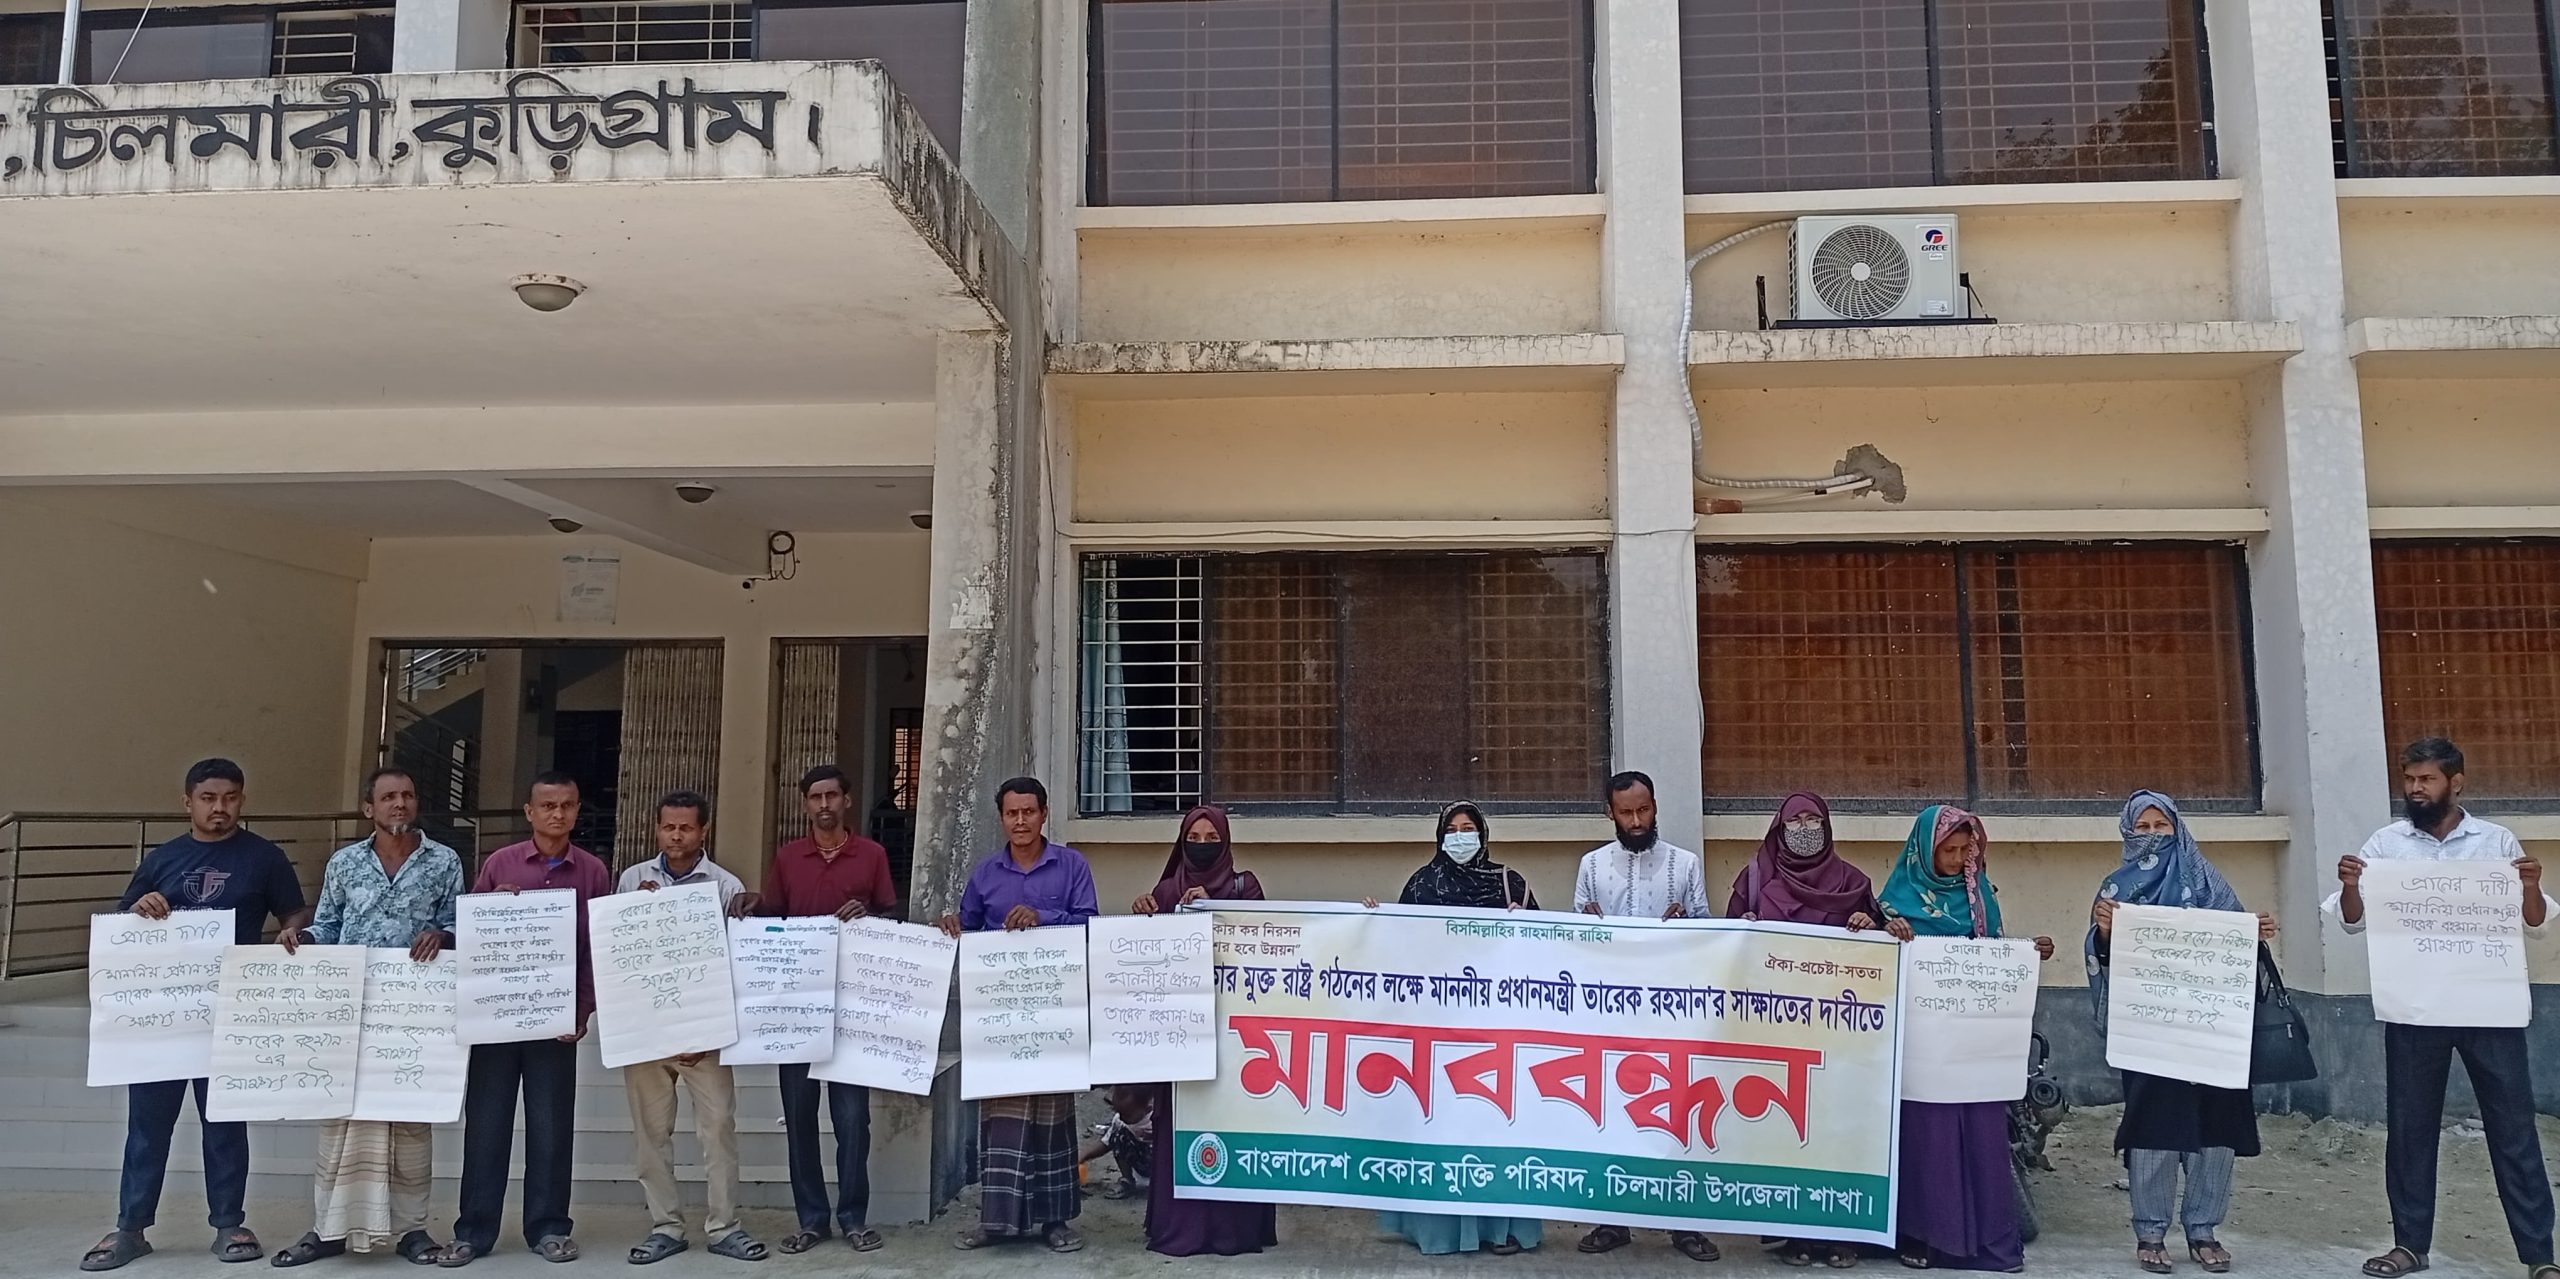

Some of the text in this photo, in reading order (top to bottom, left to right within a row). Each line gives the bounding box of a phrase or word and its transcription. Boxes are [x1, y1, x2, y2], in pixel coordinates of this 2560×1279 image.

[1234, 943, 1256, 955] হবে
[1239, 925, 1259, 936] কর
[1263, 922, 1301, 937] নিরসন
[1446, 920, 1612, 944] বিসমিল্লাহির রাহমানির রাহিম
[1243, 967, 1277, 1004] মুক্ত
[1282, 958, 1313, 1001] রাষ্ট্র
[1319, 956, 1377, 1001] গঠনের
[1382, 973, 1424, 1004] লক্ষে
[1429, 965, 1492, 1008] মাননীয়
[1497, 970, 1577, 1016] প্রধানমন্ত্রী
[1582, 980, 1642, 1016] তারেক
[1731, 989, 1813, 1027] সাক্ষাতের
[1818, 988, 1887, 1032] দাবীতে
[1228, 1015, 1826, 1153] মানববন্ধন
[1235, 1147, 1351, 1179] বাংলাদেশ
[1359, 1157, 1435, 1186] বেকার
[1442, 1154, 1496, 1195] মুক্তি
[1504, 1155, 1594, 1199] পরিষদ,
[1605, 1164, 1698, 1203] চিলমারী
[1704, 1172, 1801, 1211] উপজেলা
